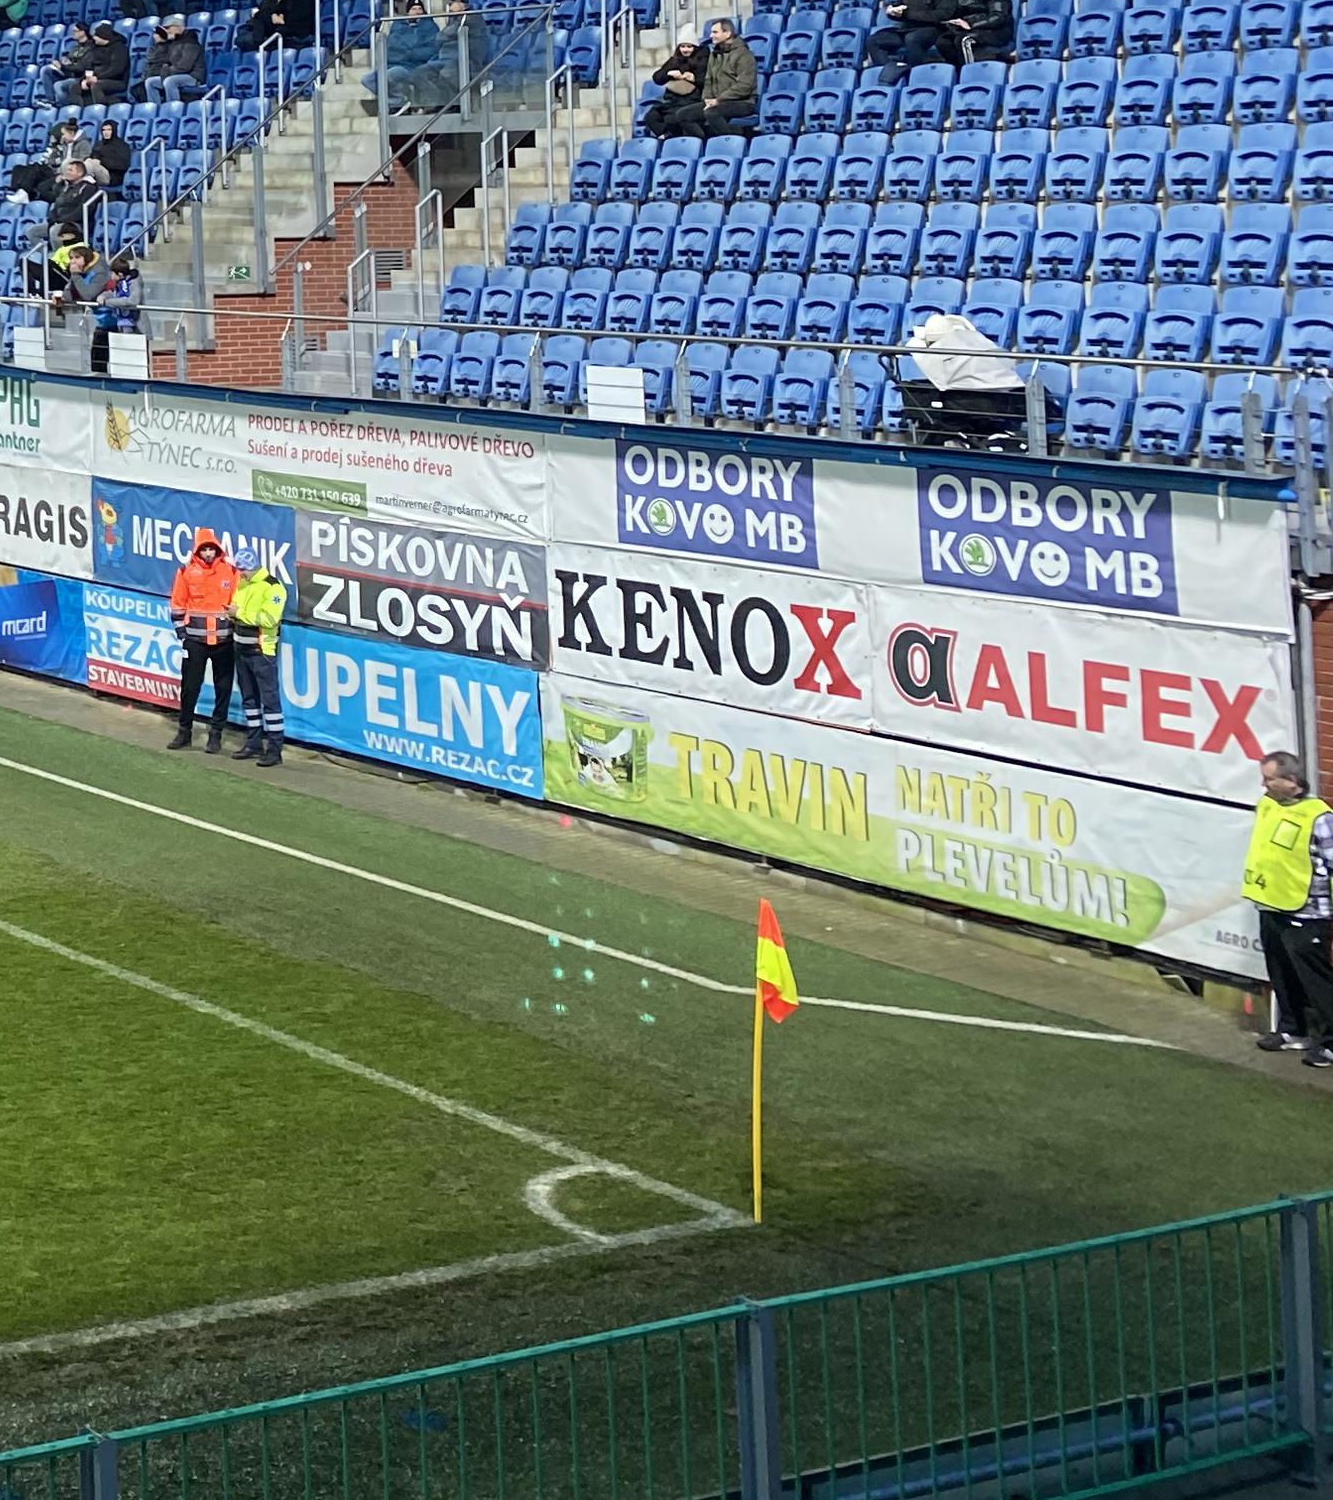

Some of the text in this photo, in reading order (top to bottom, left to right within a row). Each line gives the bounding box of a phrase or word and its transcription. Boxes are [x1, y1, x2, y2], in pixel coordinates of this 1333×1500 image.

[127, 404, 237, 439] AGROFARMA
[248, 414, 294, 434] PRODEJ
[297, 419, 308, 435] A
[311, 419, 354, 440] POŘEZ
[409, 429, 479, 453] PALIVOVÉ
[483, 432, 535, 459] DŘEVO
[144, 436, 238, 474] TÝNEC s.r.o.
[248, 439, 453, 478] Sušení a prodej sušeného dřeva
[624, 444, 802, 502] ODBORY
[341, 491, 361, 507] 639
[928, 473, 1158, 539] ODBORY
[310, 516, 530, 595] PÍSKOVNA
[745, 507, 807, 555] MB
[1084, 545, 1164, 599] MB
[1, 610, 47, 637] mcard
[312, 573, 533, 662] ZLOSYŇ
[555, 568, 863, 701] KENOX
[279, 642, 531, 757] UPELNY
[966, 643, 1266, 763] ALFEX
[363, 729, 535, 788] WWW.REZAC.CZ
[668, 731, 870, 843] TRAVIN
[895, 764, 1078, 847] NATŘI TO
[896, 826, 1131, 928] PLEVELŮM!
[1215, 929, 1250, 949] AGRO
